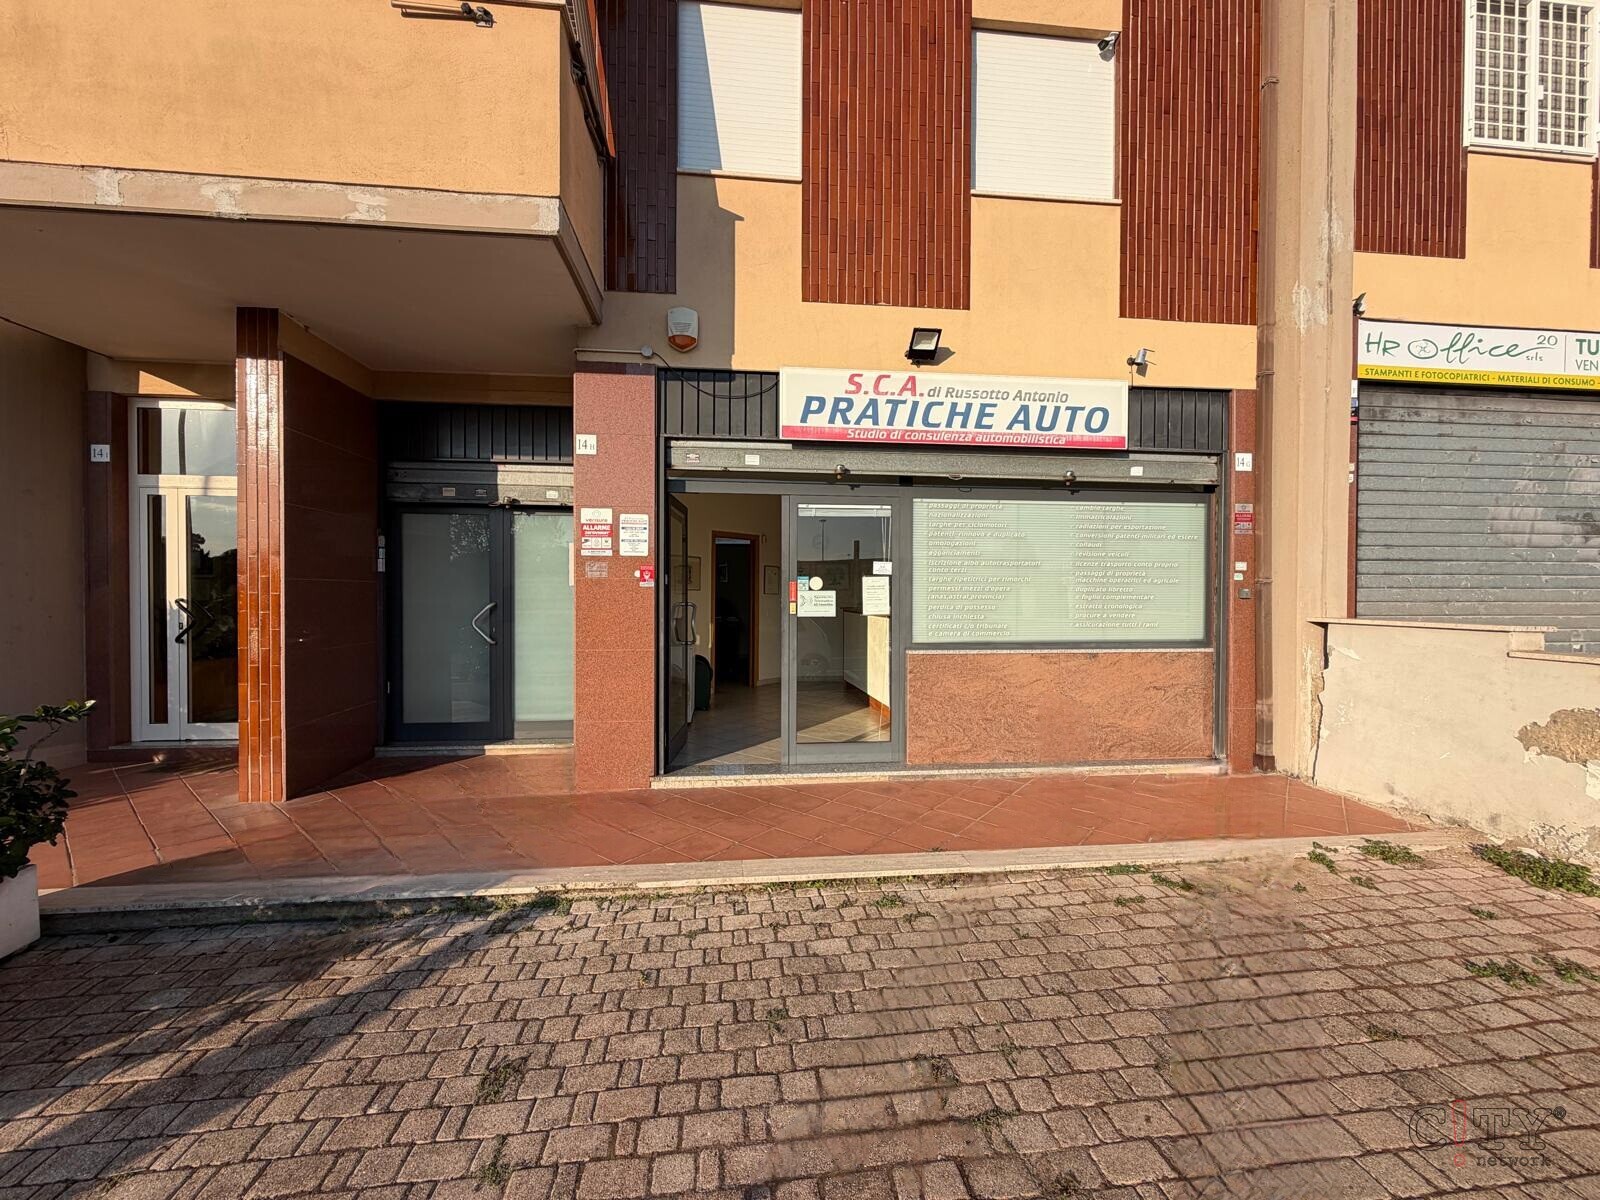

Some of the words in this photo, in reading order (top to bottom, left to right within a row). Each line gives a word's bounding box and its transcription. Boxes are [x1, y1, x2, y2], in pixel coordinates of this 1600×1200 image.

[1365, 331, 1400, 357] HR
[1536, 334, 1558, 346] 20
[1365, 368, 1412, 379] STAMPANTI
[1414, 370, 1420, 378] E
[1422, 371, 1490, 382] FOTOCOPIATRICI
[1497, 375, 1540, 385] MATERIALI
[1542, 377, 1551, 385] DI
[1553, 376, 1596, 387] CONSUMO
[844, 373, 924, 397] S.C.A.
[927, 386, 941, 399] di
[945, 386, 1010, 401] Russotto
[1012, 389, 1069, 404] Antonio
[799, 395, 998, 430] PRATICHE
[1006, 404, 1110, 434] AUTO
[578, 439, 587, 450] 14
[847, 428, 887, 440] Studio
[890, 429, 903, 440] di
[905, 430, 972, 443] consulenza
[975, 433, 1067, 446] automobilistica
[1237, 457, 1245, 467] 14
